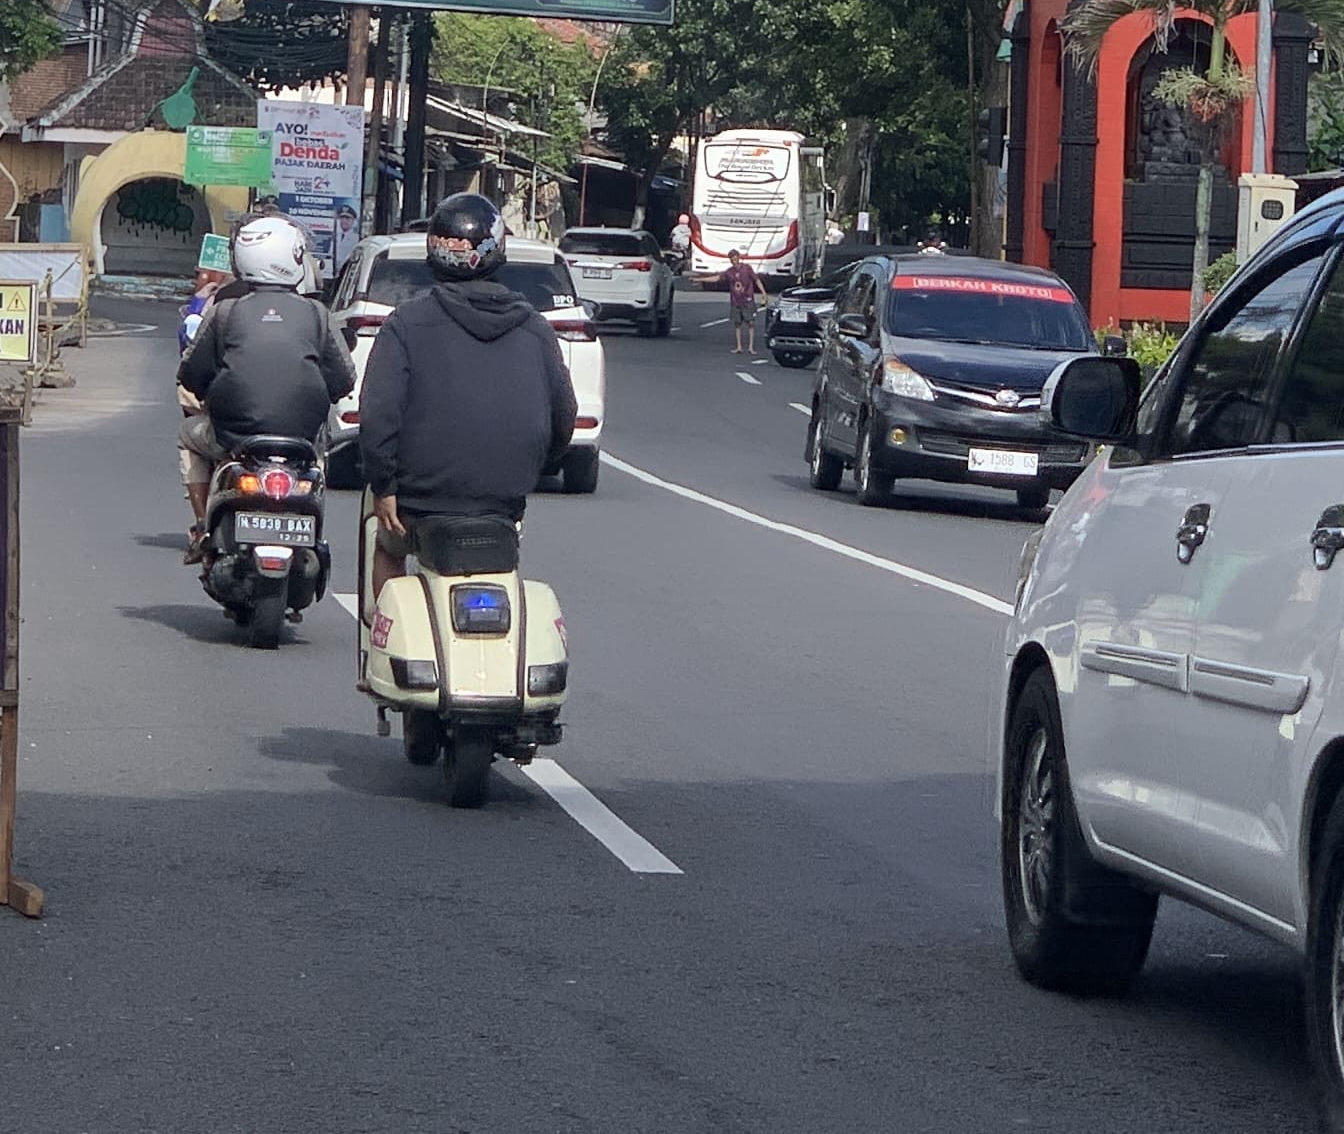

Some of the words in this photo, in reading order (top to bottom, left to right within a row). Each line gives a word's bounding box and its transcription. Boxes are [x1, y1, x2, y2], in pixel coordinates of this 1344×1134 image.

[275, 122, 308, 135] AYO!
[280, 142, 340, 161] Denda
[274, 157, 306, 168] PAJAK
[306, 160, 346, 171] DAERAH
